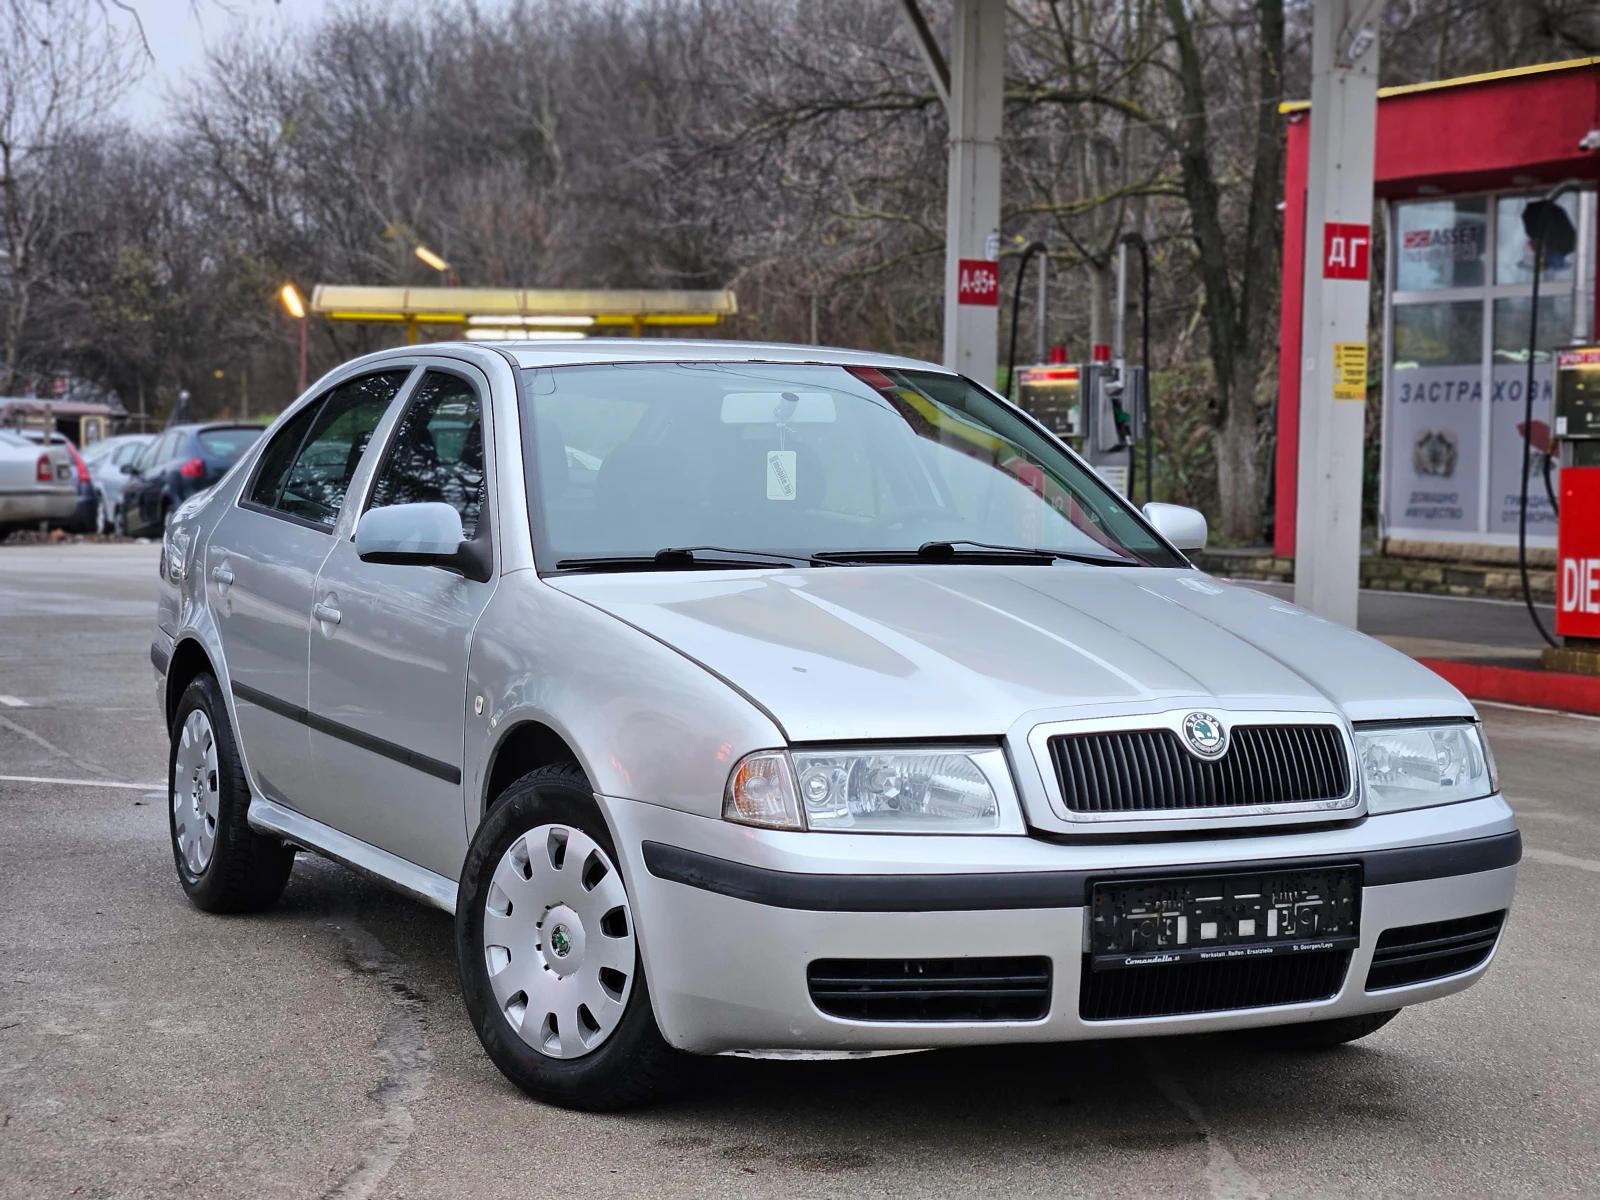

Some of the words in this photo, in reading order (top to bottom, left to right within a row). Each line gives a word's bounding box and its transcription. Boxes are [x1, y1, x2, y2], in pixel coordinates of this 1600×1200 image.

[1328, 237, 1367, 268] ДГ
[773, 461, 792, 495] mobile.bg
[1563, 557, 1600, 614] DIE
